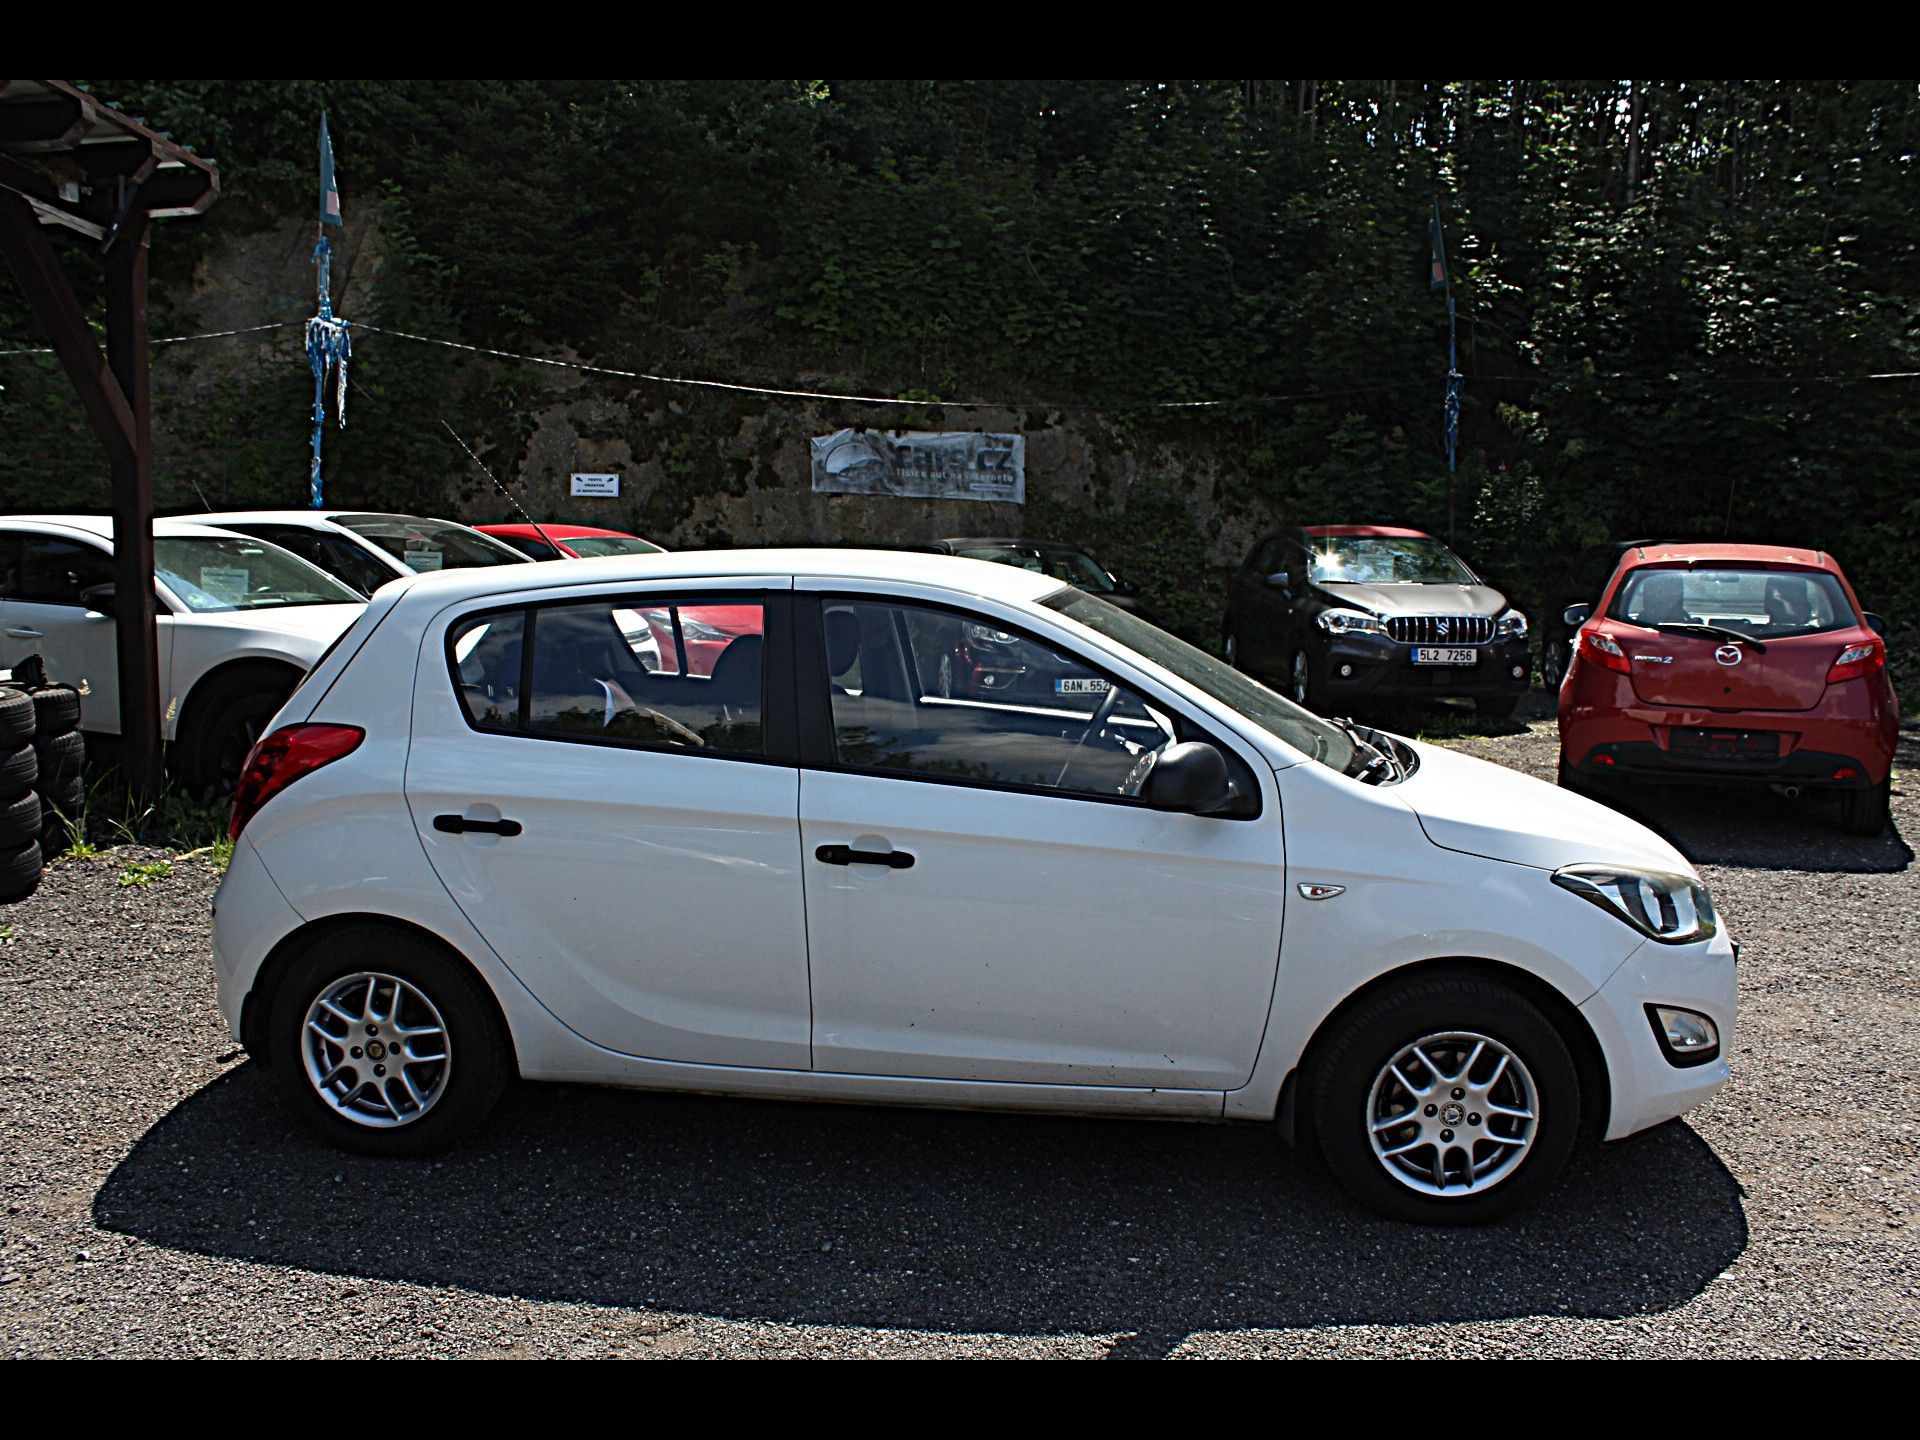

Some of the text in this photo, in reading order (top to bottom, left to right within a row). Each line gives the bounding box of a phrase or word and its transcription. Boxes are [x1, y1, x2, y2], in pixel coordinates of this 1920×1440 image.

[1420, 649, 1472, 661] 5L2 7256
[1063, 680, 1083, 692] 6AN
